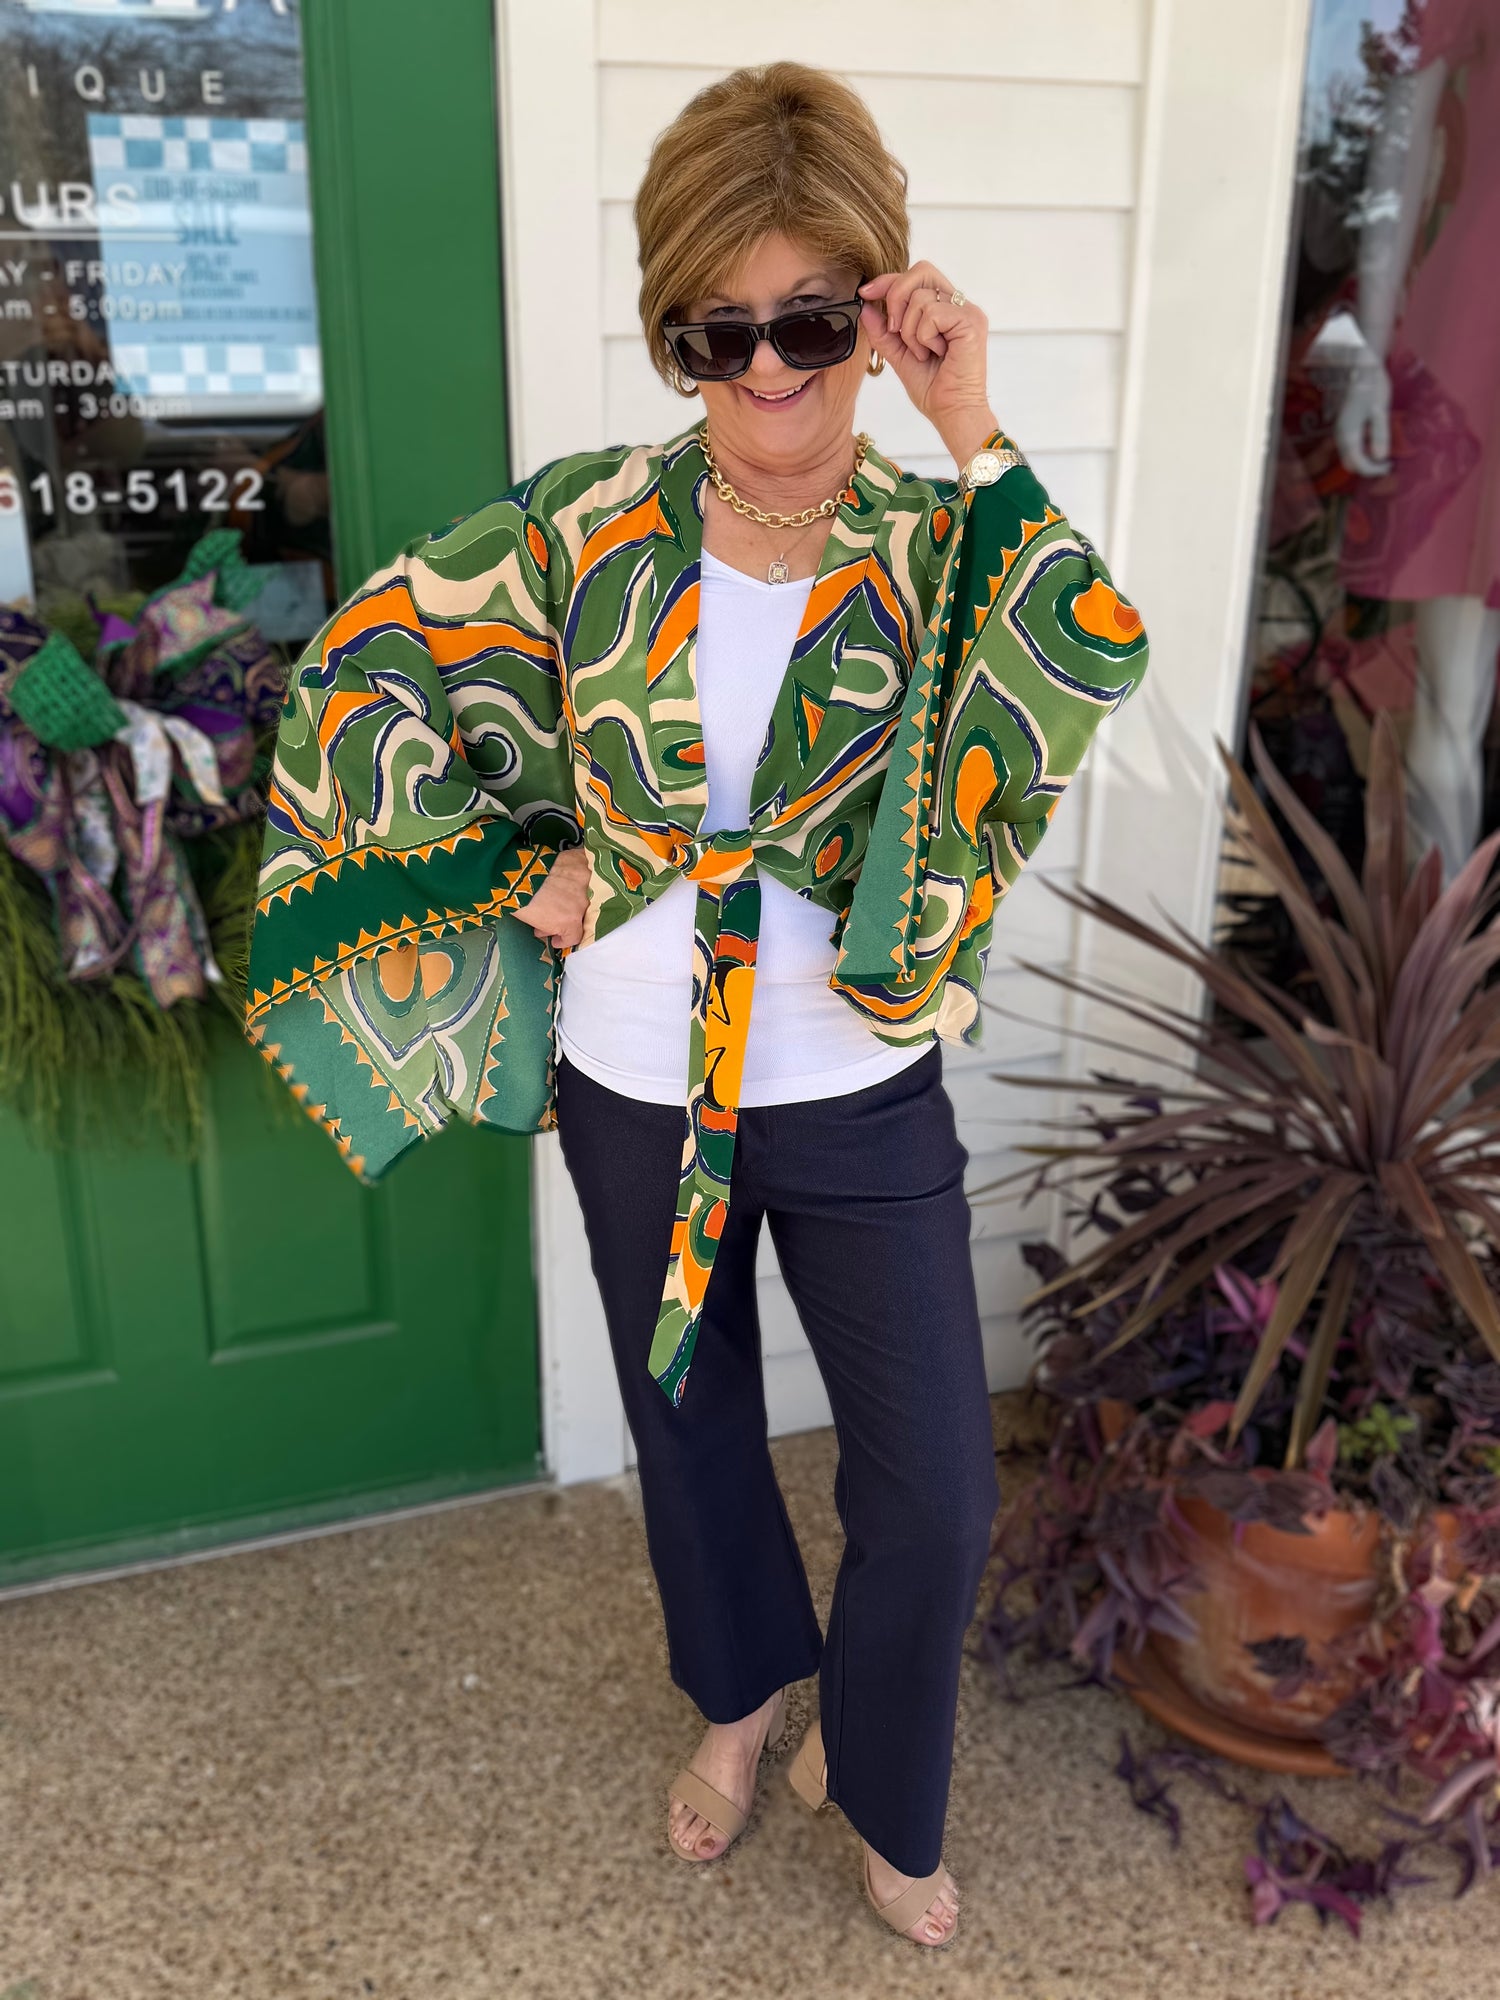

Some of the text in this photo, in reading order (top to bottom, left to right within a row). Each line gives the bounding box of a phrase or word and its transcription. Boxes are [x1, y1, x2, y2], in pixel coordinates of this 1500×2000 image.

[0, 181, 140, 230] URS
[65, 260, 188, 288] FRIDAY
[68, 293, 184, 325] 5:00pm
[0, 359, 134, 388] TURDAY
[78, 392, 192, 424] 3:00pm
